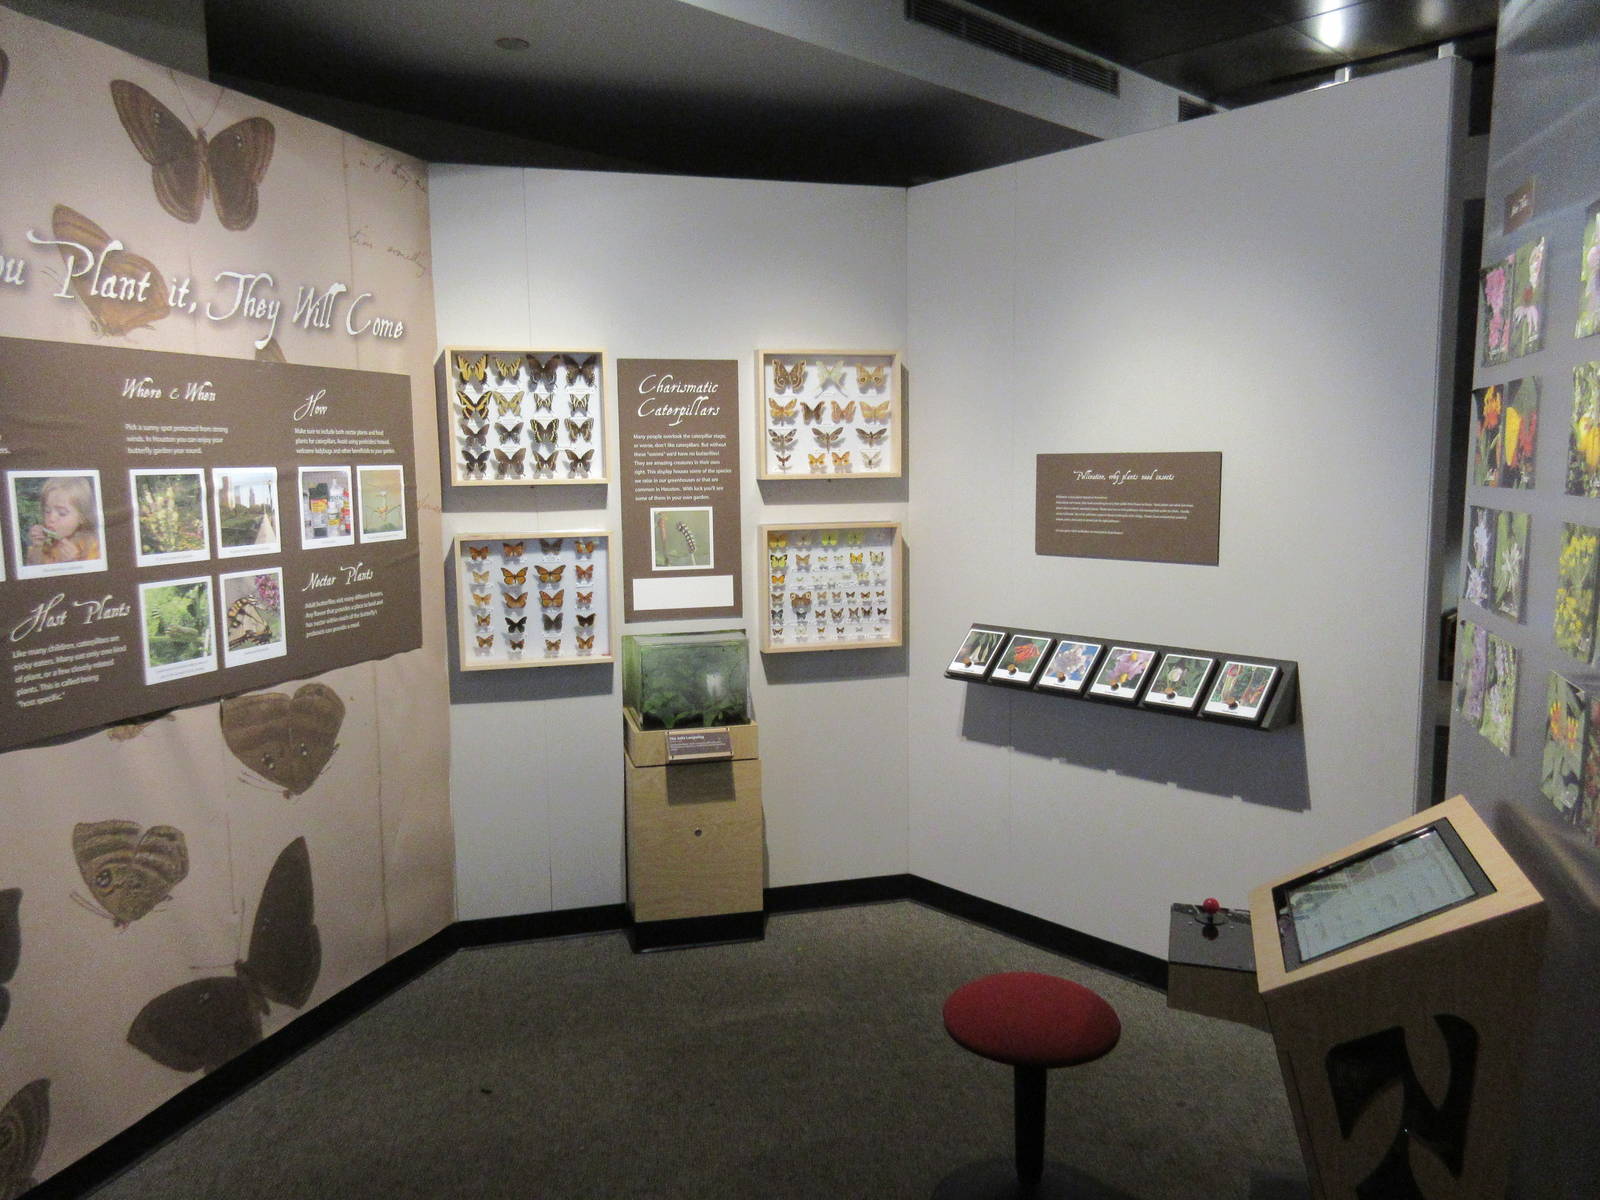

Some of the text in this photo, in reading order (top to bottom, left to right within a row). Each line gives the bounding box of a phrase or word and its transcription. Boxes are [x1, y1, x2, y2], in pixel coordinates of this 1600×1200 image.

[26, 229, 150, 301] Plant
[168, 278, 196, 314] it,
[206, 271, 280, 350] They
[292, 282, 346, 330] Will
[346, 293, 404, 339] Come
[122, 377, 162, 399] Where
[184, 381, 216, 402] When
[638, 374, 719, 394] Charismatic
[293, 389, 328, 422] How
[637, 396, 720, 426] Caterpillars
[302, 562, 374, 592] Nectar Plants
[10, 593, 131, 642] Host Plants
